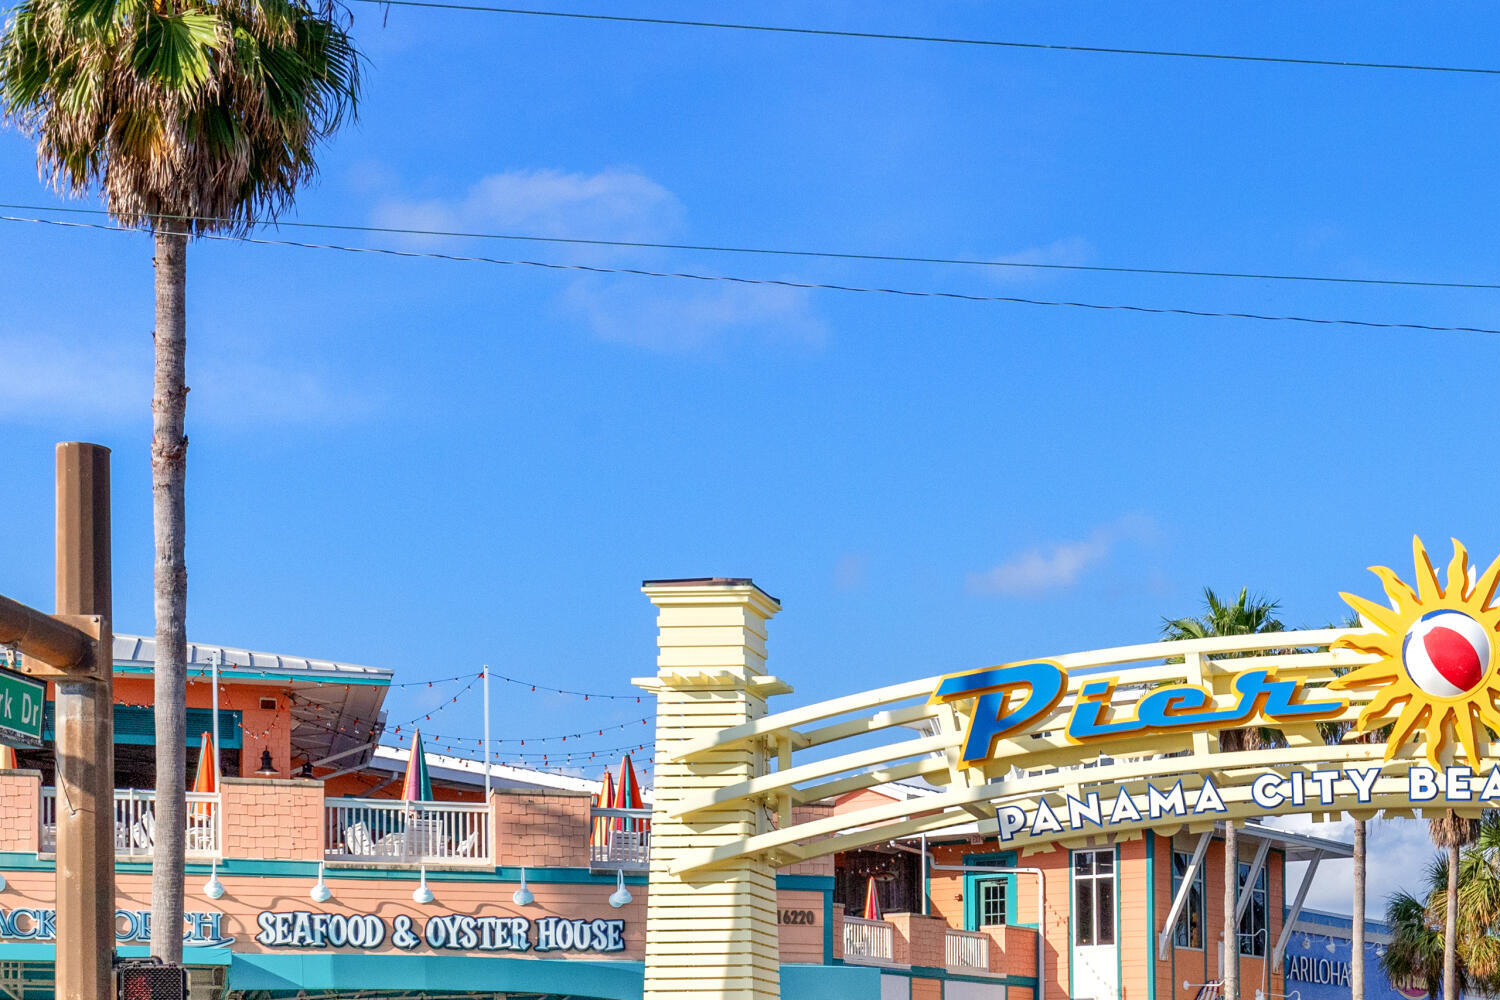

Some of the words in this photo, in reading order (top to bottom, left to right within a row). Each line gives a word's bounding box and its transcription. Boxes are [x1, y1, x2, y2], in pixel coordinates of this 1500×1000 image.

[21, 692, 39, 727] Dr
[927, 658, 1350, 770] Pier
[996, 773, 1228, 842] PANAMA
[1251, 767, 1382, 809] CITY
[0, 908, 56, 940] CK
[256, 912, 386, 949] SEAFOOD
[391, 914, 421, 951] &
[425, 914, 532, 952] OYSTER
[534, 916, 625, 952] HOUSE
[777, 910, 815, 925] 16220
[1286, 954, 1351, 987] ARILOHA
